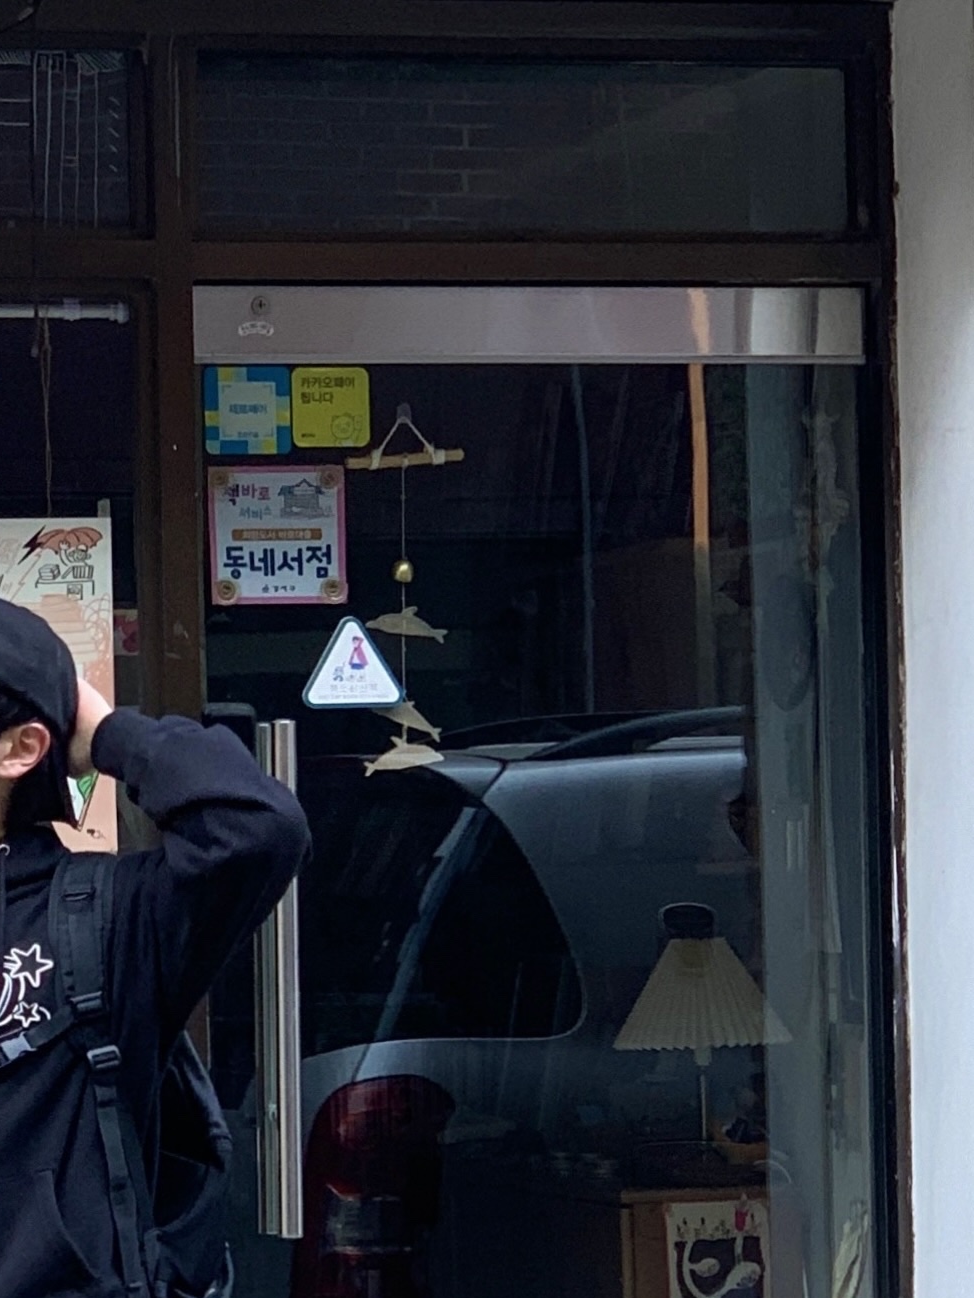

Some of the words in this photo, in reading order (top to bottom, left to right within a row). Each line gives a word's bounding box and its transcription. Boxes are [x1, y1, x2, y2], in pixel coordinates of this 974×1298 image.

[301, 376, 356, 389] 카카오페이
[301, 391, 334, 405] 됩니다
[239, 505, 272, 521] 서비스
[223, 544, 333, 580] 동네서점
